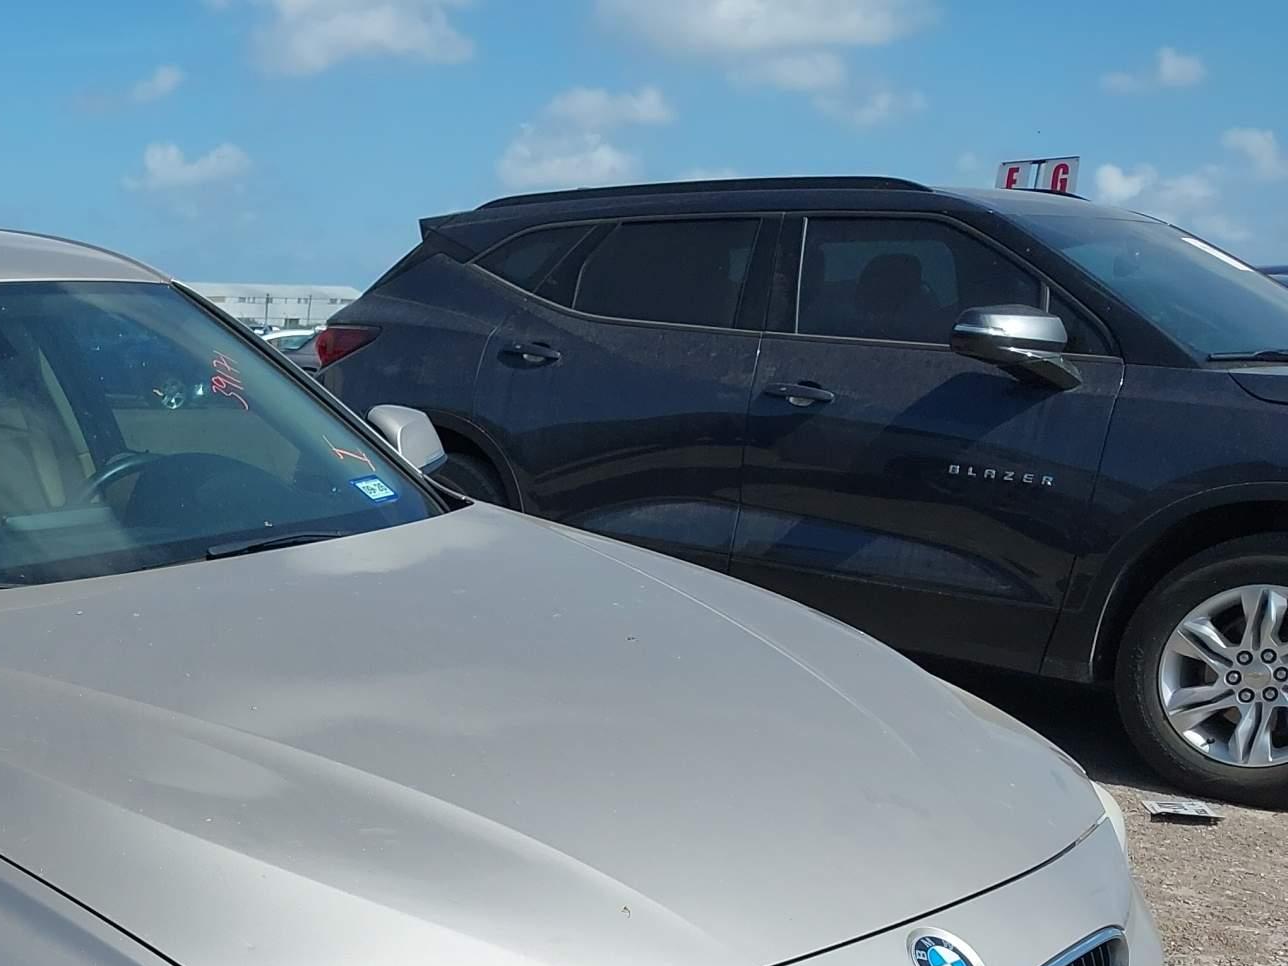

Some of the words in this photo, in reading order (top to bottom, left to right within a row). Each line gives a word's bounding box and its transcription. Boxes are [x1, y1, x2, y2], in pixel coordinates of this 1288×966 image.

[1050, 162, 1070, 192] G
[948, 464, 1054, 486] BLAZER
[915, 937, 954, 961] BMW
